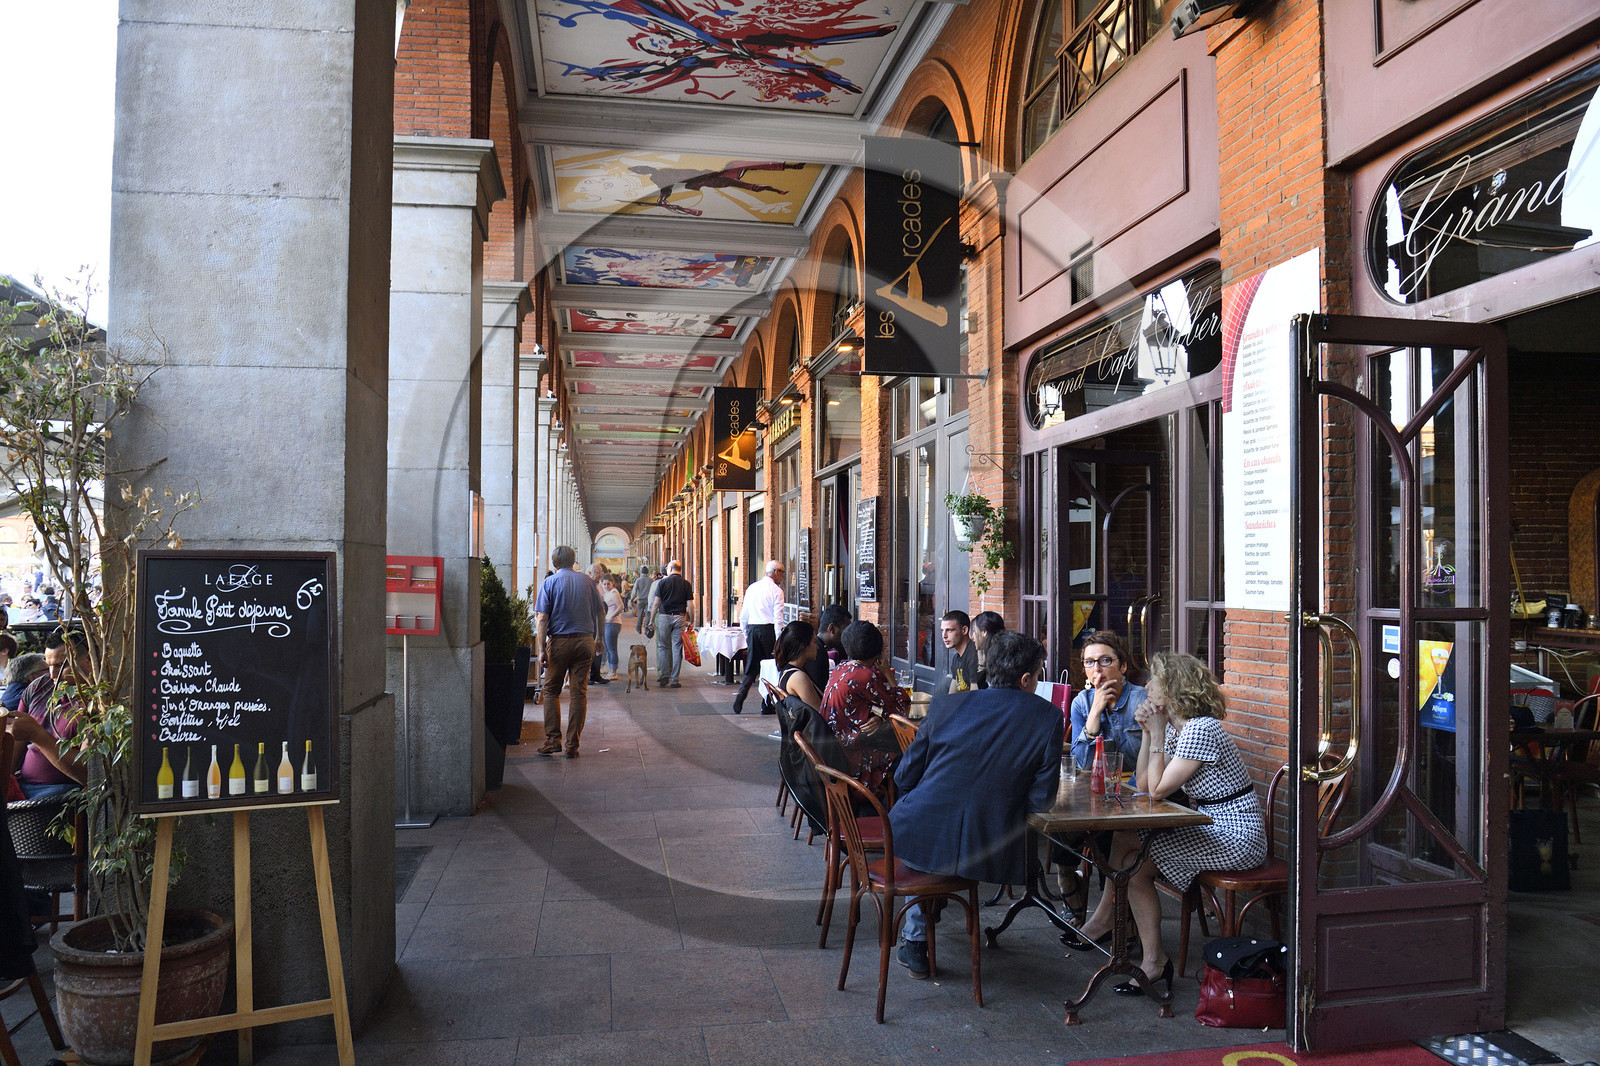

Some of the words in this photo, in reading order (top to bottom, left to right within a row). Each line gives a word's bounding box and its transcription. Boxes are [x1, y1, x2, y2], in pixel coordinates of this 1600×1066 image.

[875, 310, 896, 339] les
[1094, 320, 1141, 394] Café
[1155, 278, 1222, 350] Alber
[204, 677, 242, 693] Chaude
